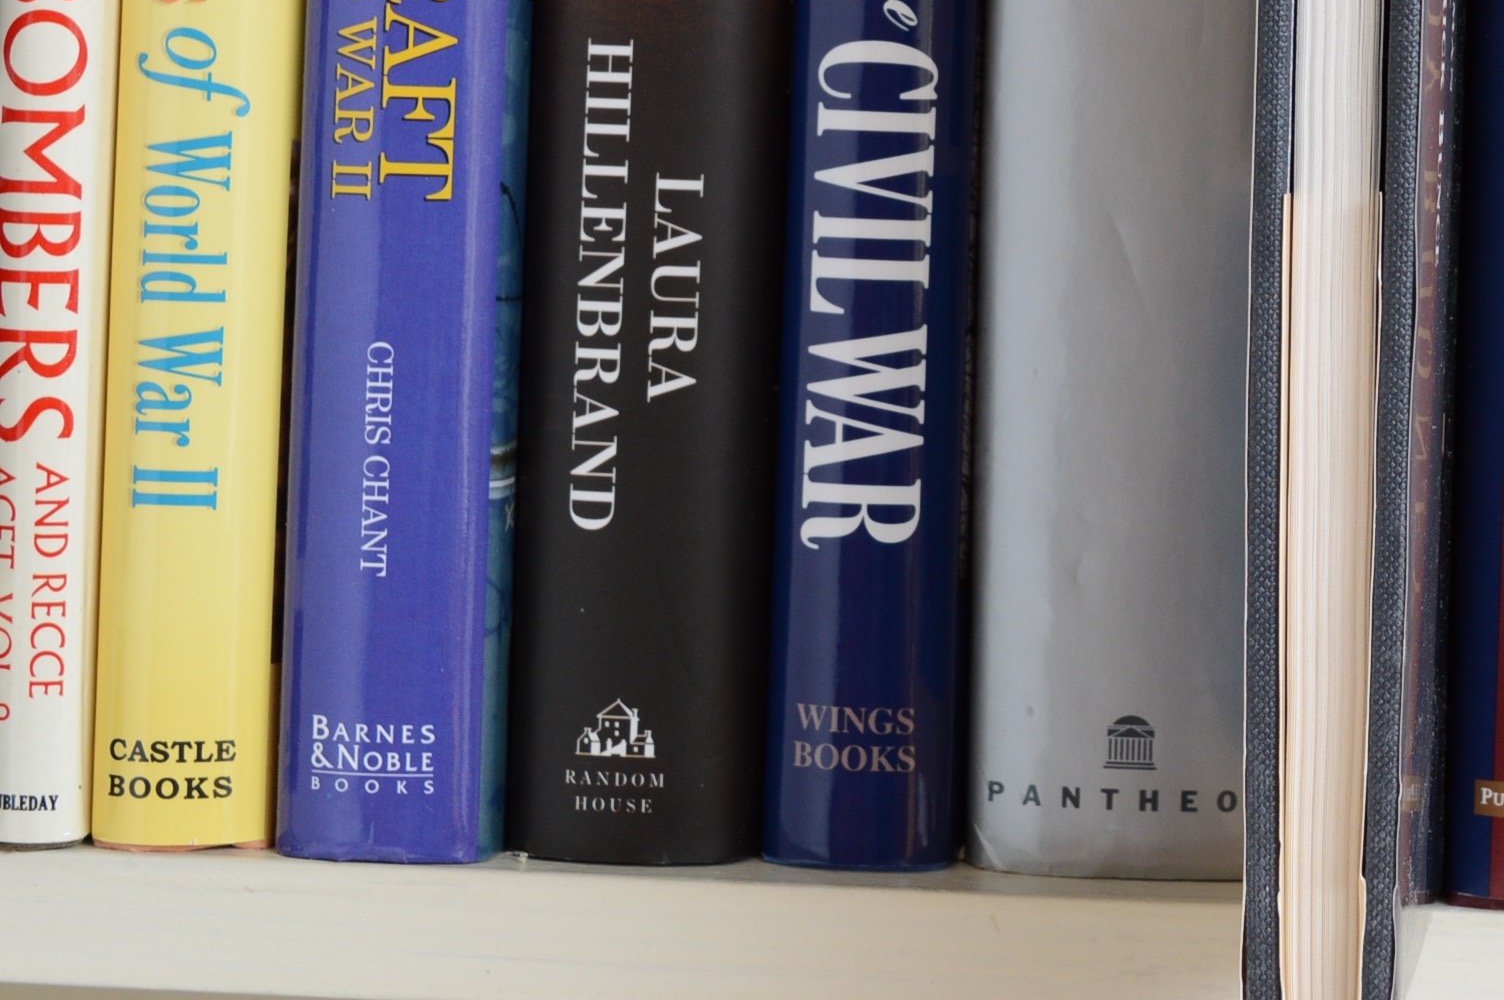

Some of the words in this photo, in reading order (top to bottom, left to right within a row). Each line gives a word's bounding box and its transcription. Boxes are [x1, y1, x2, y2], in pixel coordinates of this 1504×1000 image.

[138, 27, 250, 118] of
[332, 17, 377, 143] WAR
[331, 160, 372, 201] II
[810, 40, 939, 315] CIVIL
[140, 130, 233, 304] World
[569, 38, 634, 531] HILLENBRAND
[647, 172, 704, 402] LAURA
[135, 326, 224, 447] War
[362, 341, 394, 447] CHRIS
[800, 323, 928, 550] WAR
[34, 461, 70, 558] AND
[132, 465, 219, 512] II
[360, 453, 391, 577] CHANT
[29, 573, 68, 699] RECCE
[109, 738, 236, 764] CASTLE
[311, 714, 436, 743] BARNES
[796, 702, 915, 735] WINGS
[108, 774, 233, 800] BOOKS
[311, 775, 435, 795] BOOKS
[565, 768, 664, 788] RANDOM
[793, 740, 916, 773] BOOKS
[0, 793, 59, 811] BLEDAY
[575, 795, 652, 813] HOUSE
[988, 779, 1238, 814] PANTHEO
